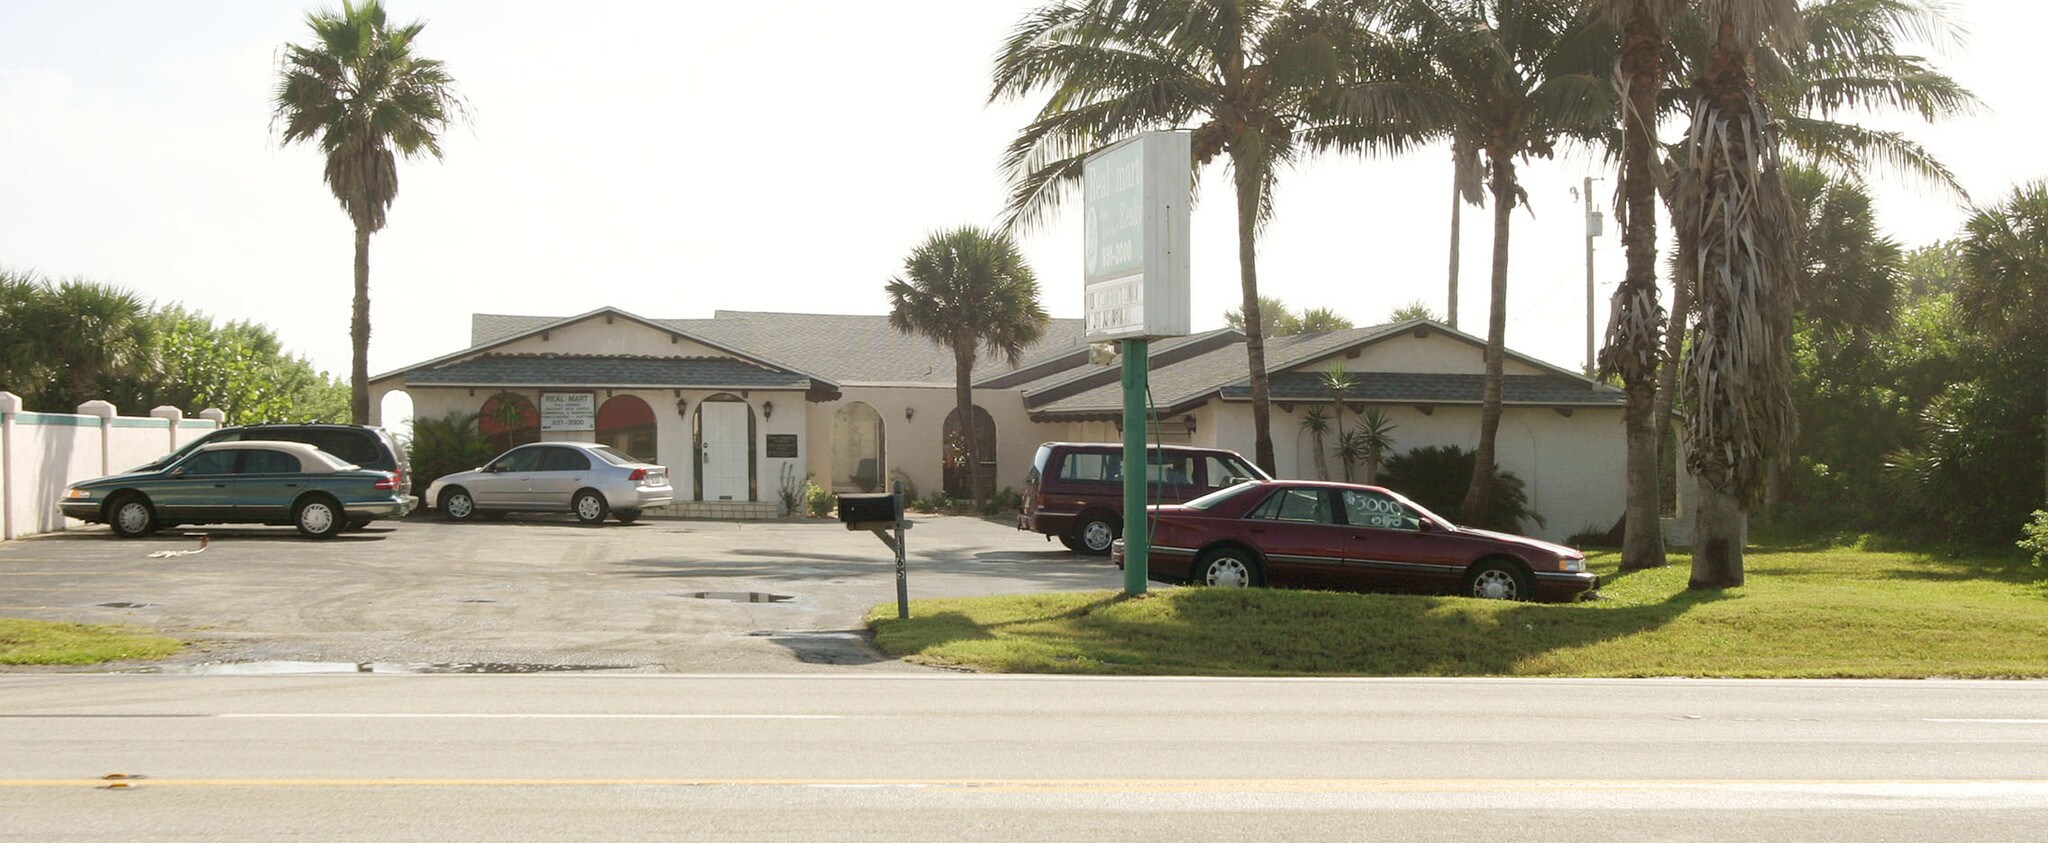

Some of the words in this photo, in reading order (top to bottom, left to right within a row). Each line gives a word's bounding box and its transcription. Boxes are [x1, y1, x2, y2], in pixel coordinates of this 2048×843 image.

[1089, 160, 1110, 203] Real
[1115, 159, 1141, 193] mart
[1343, 490, 1403, 515] $3000
[897, 536, 905, 579] 1165
